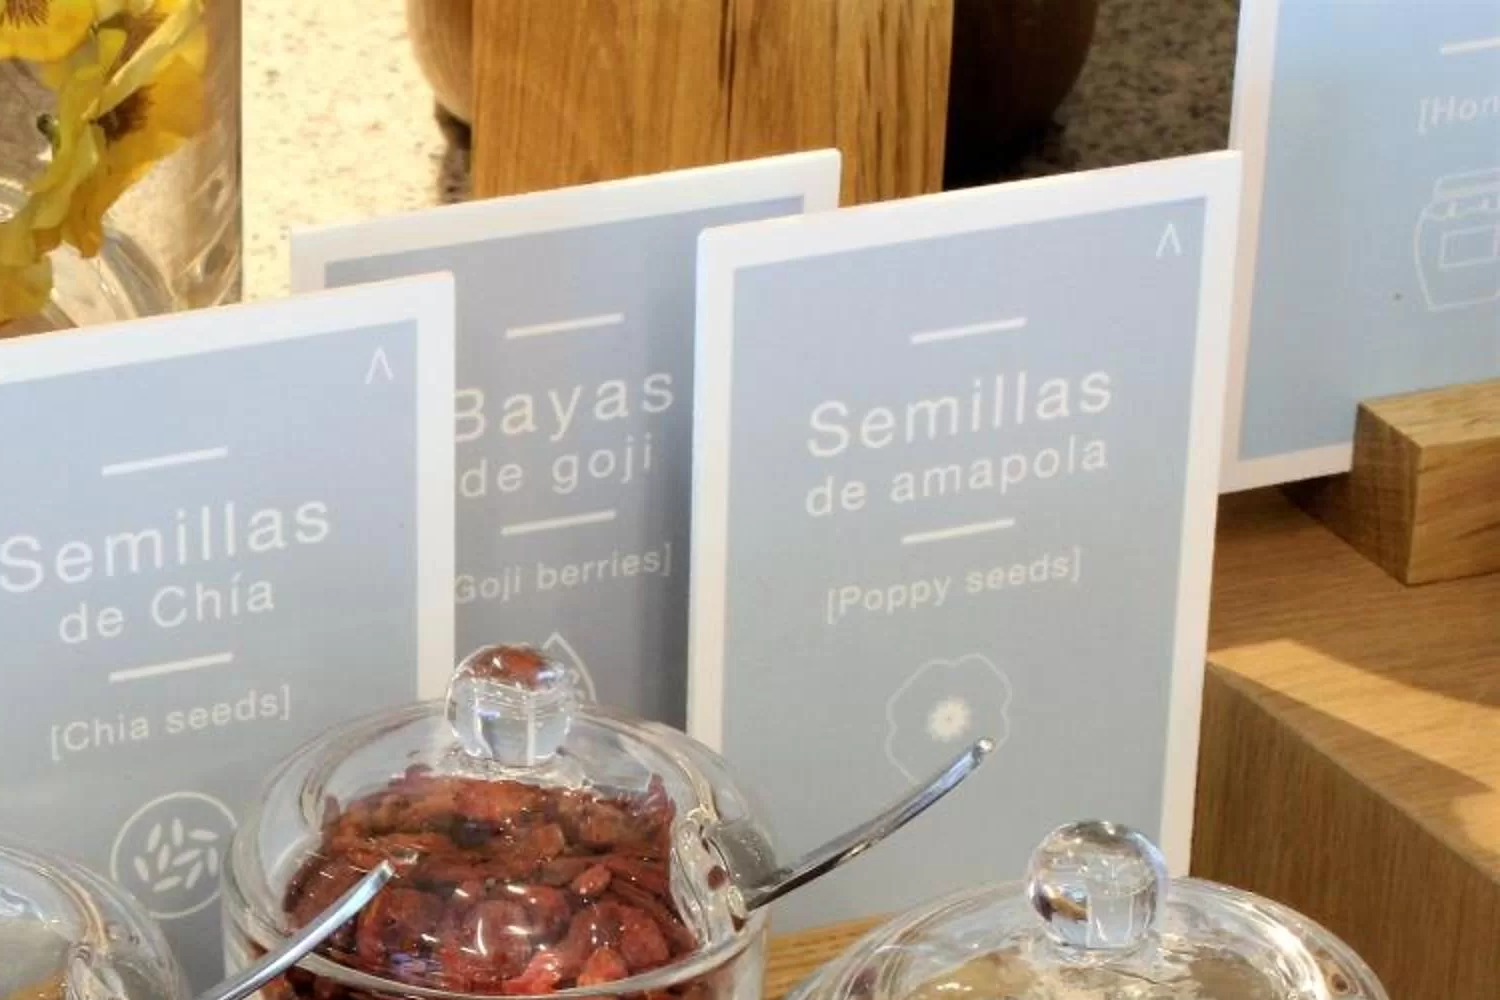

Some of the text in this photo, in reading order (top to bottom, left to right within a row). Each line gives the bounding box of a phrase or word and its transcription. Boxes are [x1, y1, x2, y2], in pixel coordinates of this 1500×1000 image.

[453, 372, 674, 442] Bayas
[806, 369, 1112, 458] Semillas
[460, 433, 654, 497] de goji
[805, 435, 1109, 517] de amapola
[537, 543, 673, 591] berries]
[827, 547, 1082, 625] [Poppy seeds]
[59, 572, 275, 644] de Chía
[50, 684, 292, 760] [Chia seeds]
